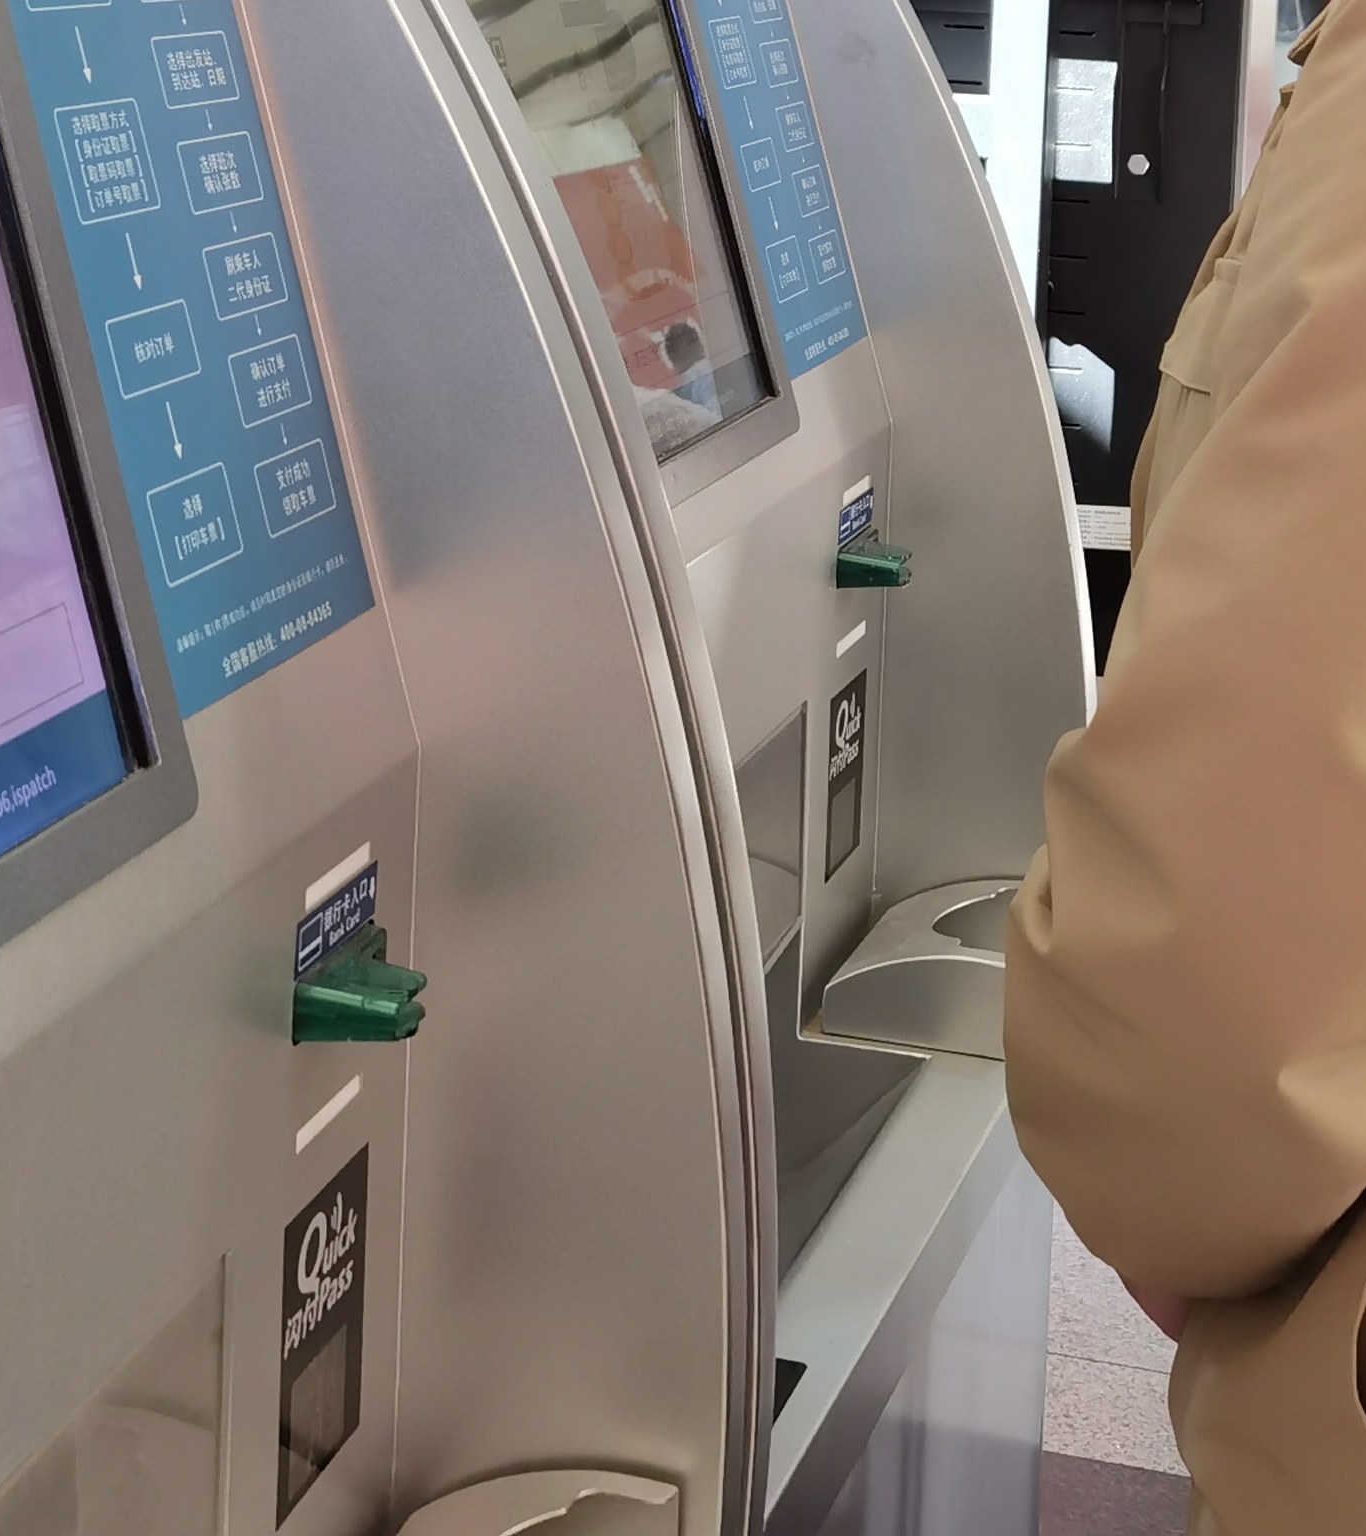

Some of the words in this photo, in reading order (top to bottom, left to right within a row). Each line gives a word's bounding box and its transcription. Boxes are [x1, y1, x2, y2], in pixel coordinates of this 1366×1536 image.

[134, 331, 175, 364] 核对订单
[276, 458, 312, 491] 支付成功
[297, 1207, 358, 1295] Quick
